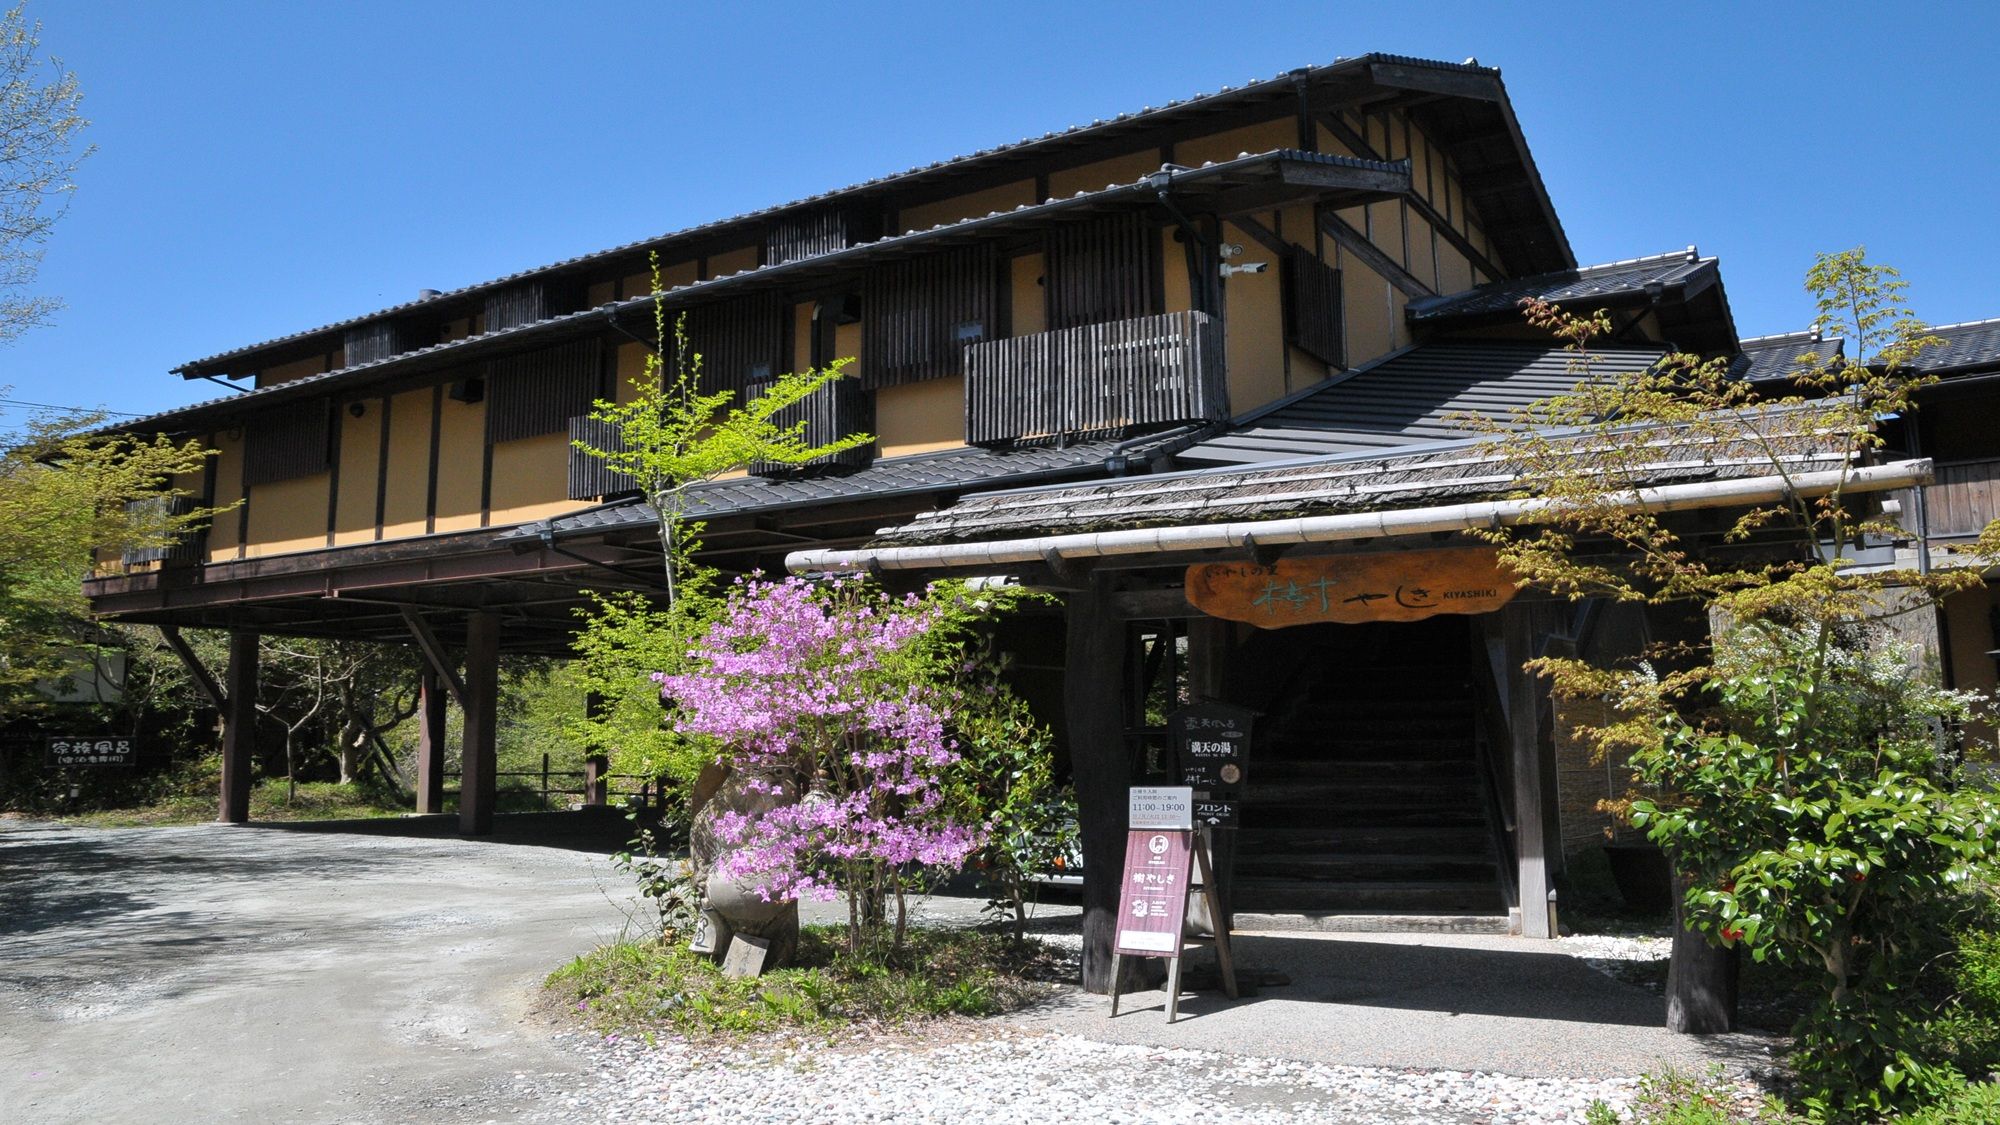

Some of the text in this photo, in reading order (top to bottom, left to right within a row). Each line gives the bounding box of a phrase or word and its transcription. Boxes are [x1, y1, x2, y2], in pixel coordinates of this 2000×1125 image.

[1443, 589, 1497, 600] KIYASHIKI
[52, 741, 130, 754] 家族風呂
[1195, 803, 1232, 813] フロント
[1133, 872, 1175, 884] 樹やしき
